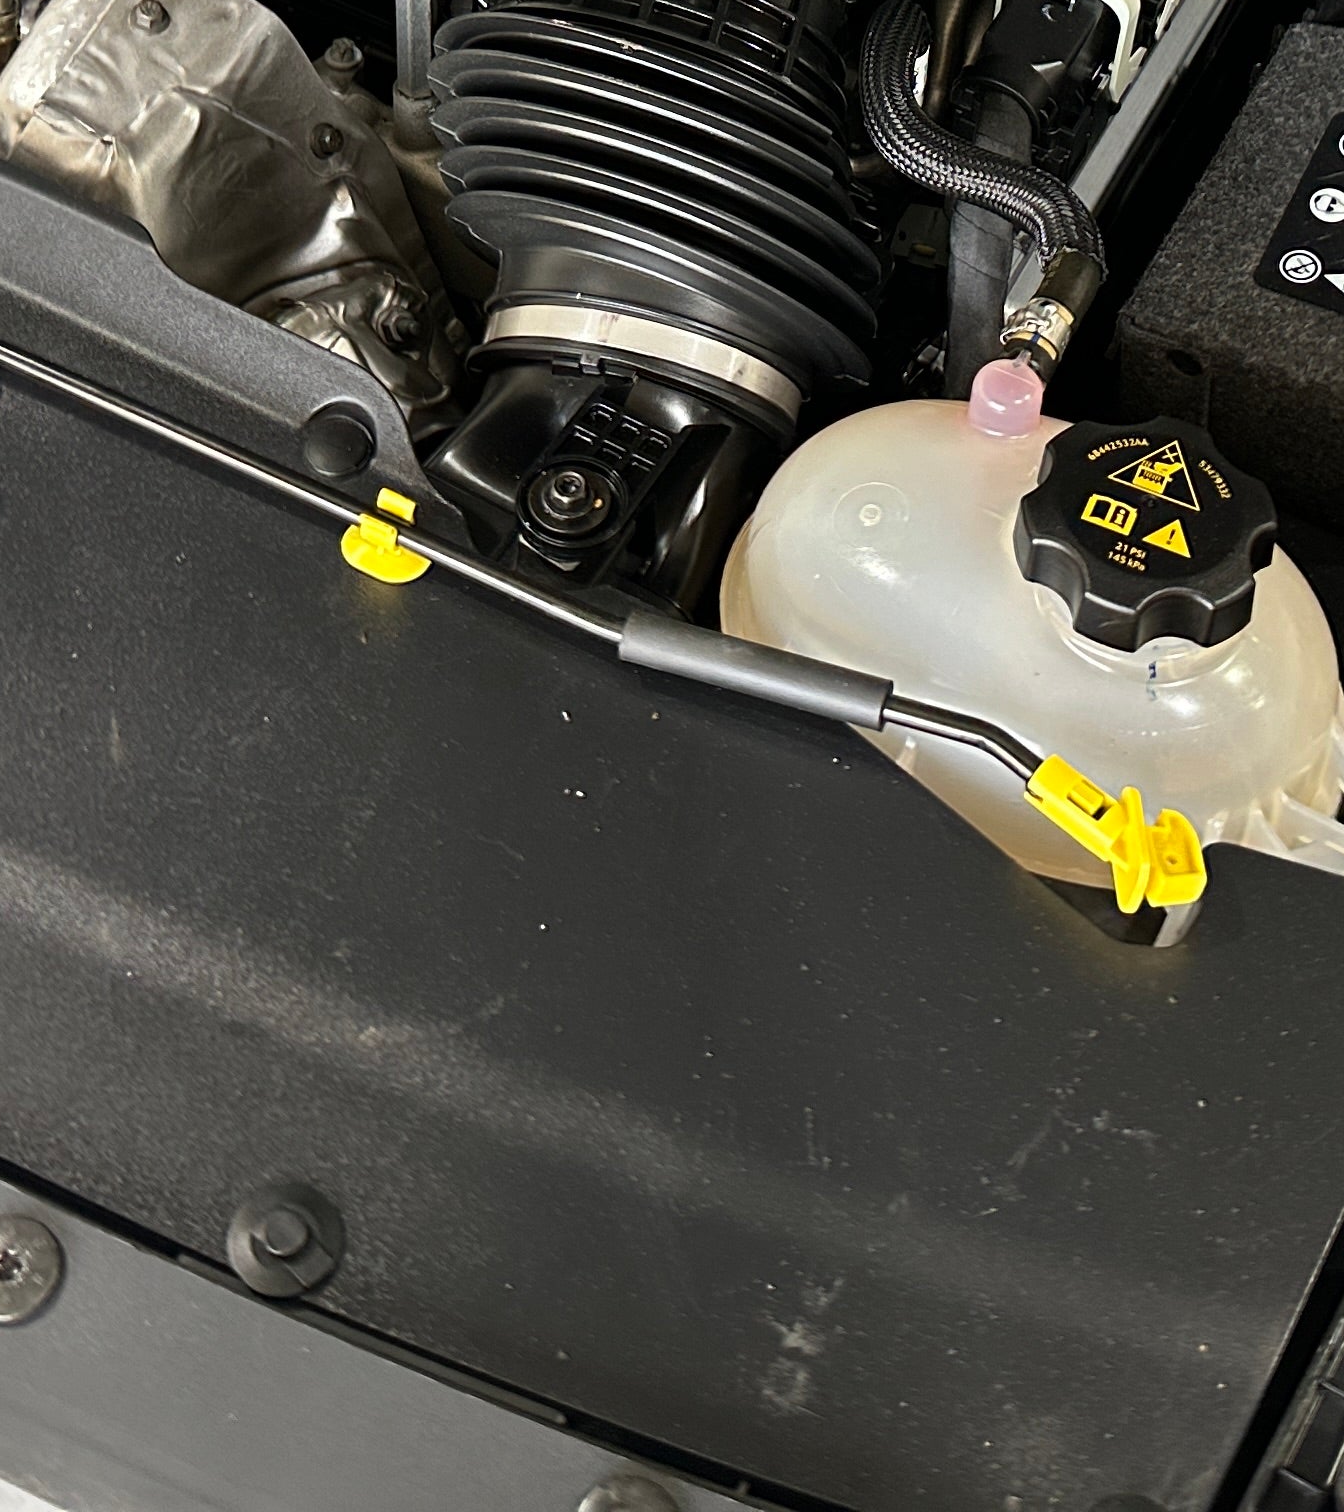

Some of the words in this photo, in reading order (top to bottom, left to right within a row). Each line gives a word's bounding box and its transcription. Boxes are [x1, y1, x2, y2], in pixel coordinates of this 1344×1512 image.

[1114, 541, 1128, 553] 21
[1129, 545, 1146, 560] PSI
[1107, 551, 1127, 565] 145
[1127, 556, 1147, 572] kPa
